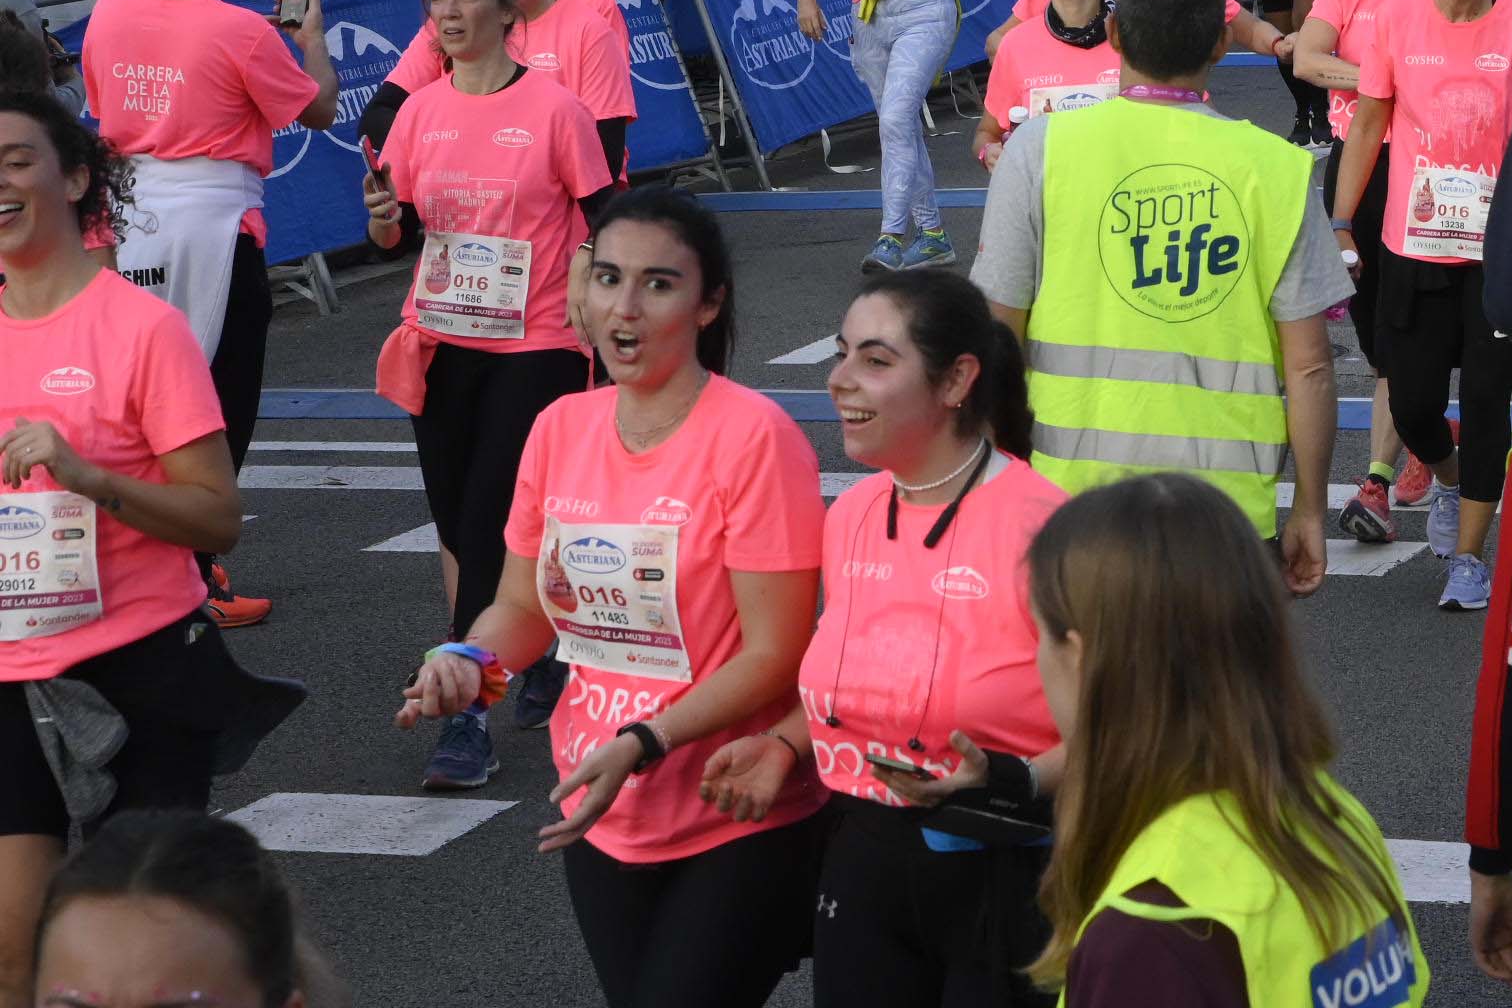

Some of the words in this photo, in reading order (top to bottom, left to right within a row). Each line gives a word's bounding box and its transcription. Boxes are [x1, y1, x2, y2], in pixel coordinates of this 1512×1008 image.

[1405, 55, 1445, 65] OYSHO
[112, 63, 185, 84] CARRERA
[128, 80, 148, 97] DE
[153, 82, 171, 98] LA
[122, 95, 172, 115] MUJER
[1111, 182, 1220, 237] Sport
[1438, 204, 1470, 218] 016
[1440, 221, 1465, 230] 13238
[1416, 229, 1441, 237] CARRERA
[456, 252, 494, 264] ASTURIANA
[1130, 223, 1240, 297] Life
[453, 274, 489, 291] 016
[455, 293, 482, 304] 11686
[425, 302, 453, 312] CARRERA
[454, 305, 463, 313] DE
[464, 306, 473, 314] LA
[43, 376, 94, 389] ASTURIANA
[567, 551, 622, 567] ASTURIANA
[631, 547, 664, 557] SUMA
[2, 598, 13, 607] DE
[14, 597, 26, 606] LA
[27, 595, 59, 606] MUJER
[579, 585, 627, 607] 016
[39, 612, 91, 626] Santander
[592, 610, 629, 626] 11483
[566, 623, 600, 637] CARRERA
[612, 631, 624, 640] LA
[626, 632, 651, 643] MUJER
[637, 653, 680, 668] Santander
